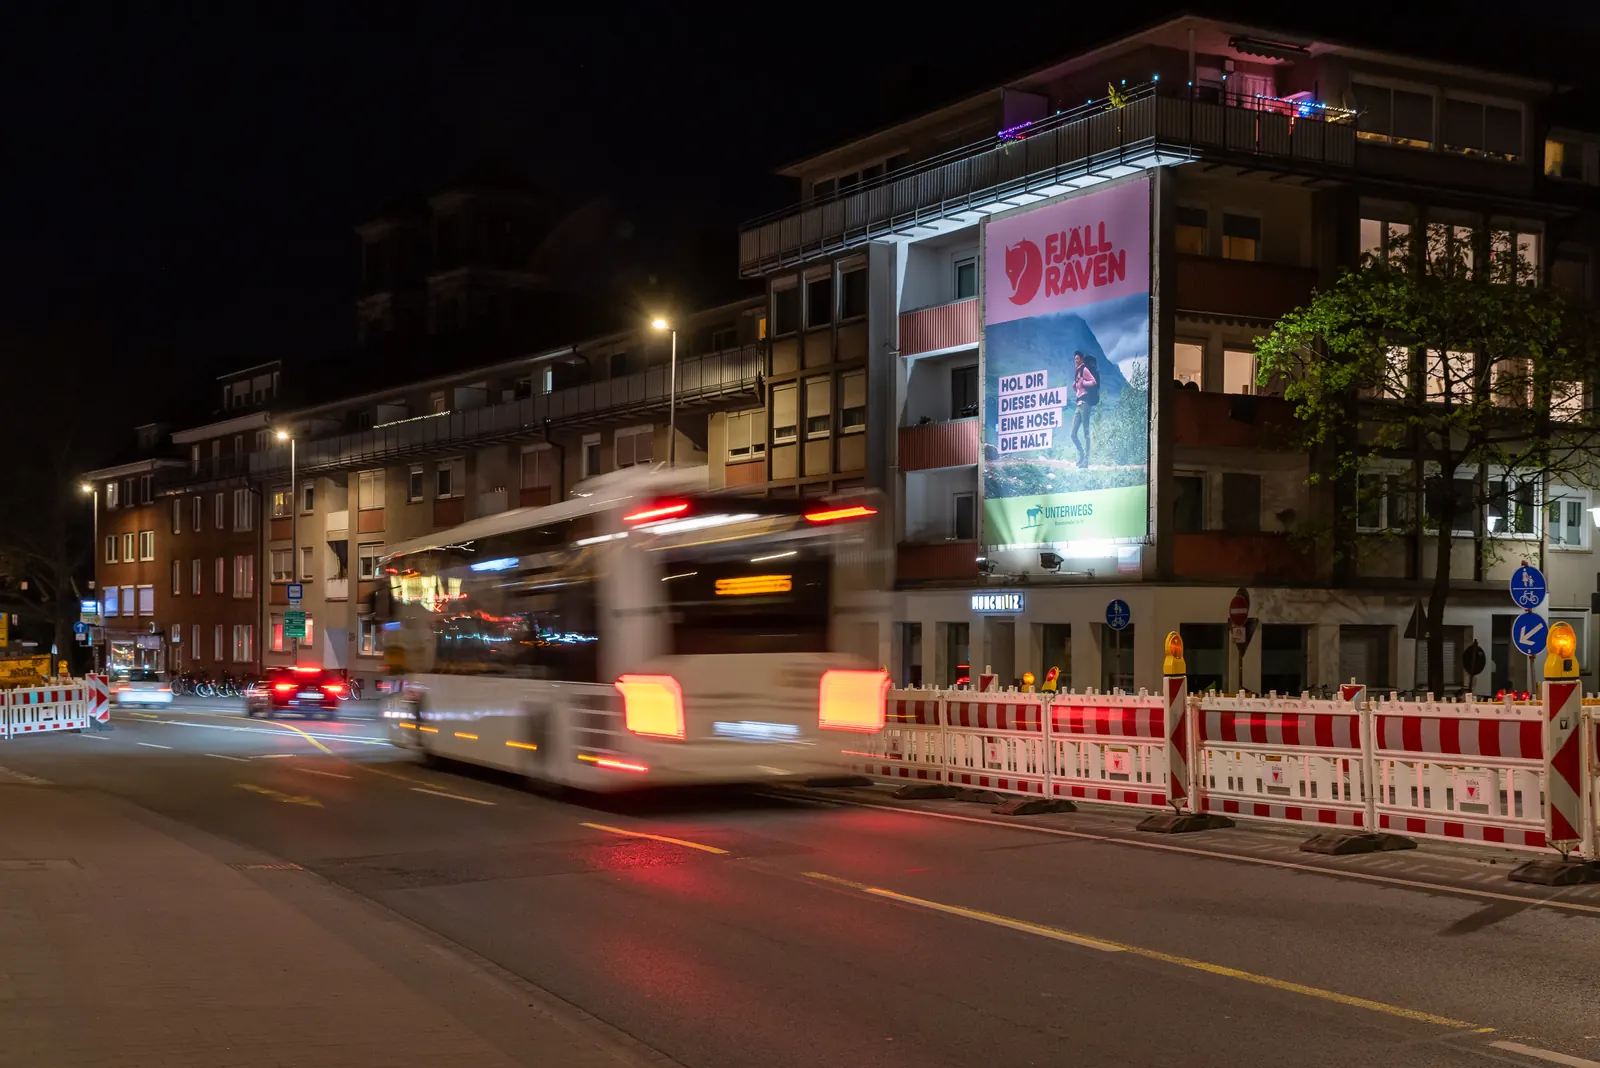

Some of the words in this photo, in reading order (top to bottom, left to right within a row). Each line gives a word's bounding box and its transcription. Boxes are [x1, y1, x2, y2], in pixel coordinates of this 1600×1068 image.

[1044, 221, 1113, 266] FJÄLL
[1044, 249, 1126, 298] RÄVEN
[1001, 376, 1023, 393] HOL
[1025, 373, 1044, 389] DIR
[1001, 393, 1037, 412] DIESES
[1039, 390, 1062, 407] MAL
[1001, 415, 1025, 432] EINE
[1026, 411, 1059, 429] HOSE,
[1001, 436, 1018, 452] DIE
[1020, 432, 1049, 450] HÄLT.
[1045, 503, 1093, 519] UNTERWEGS
